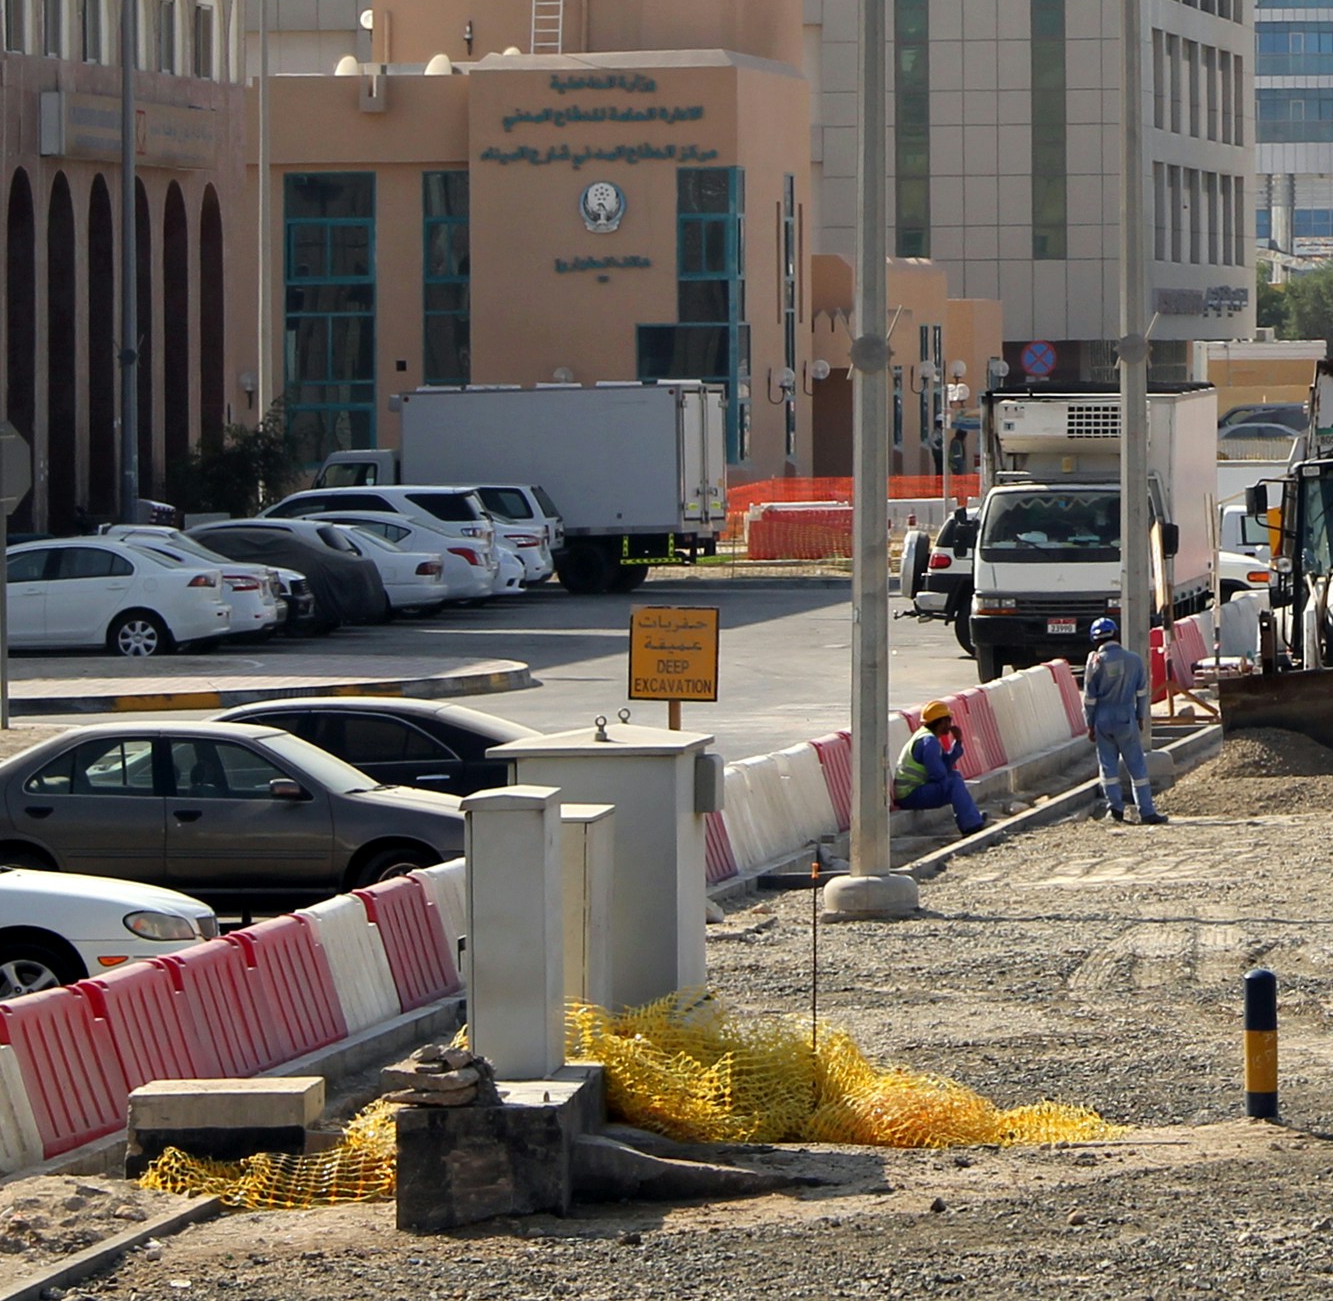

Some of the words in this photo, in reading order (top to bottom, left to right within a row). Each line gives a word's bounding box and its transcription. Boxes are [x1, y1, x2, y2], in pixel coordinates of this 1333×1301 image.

[638, 616, 708, 633] حفريات
[644, 635, 702, 655] عميقة
[656, 659, 690, 674] DEEP
[634, 678, 712, 694] EXCAVATION
